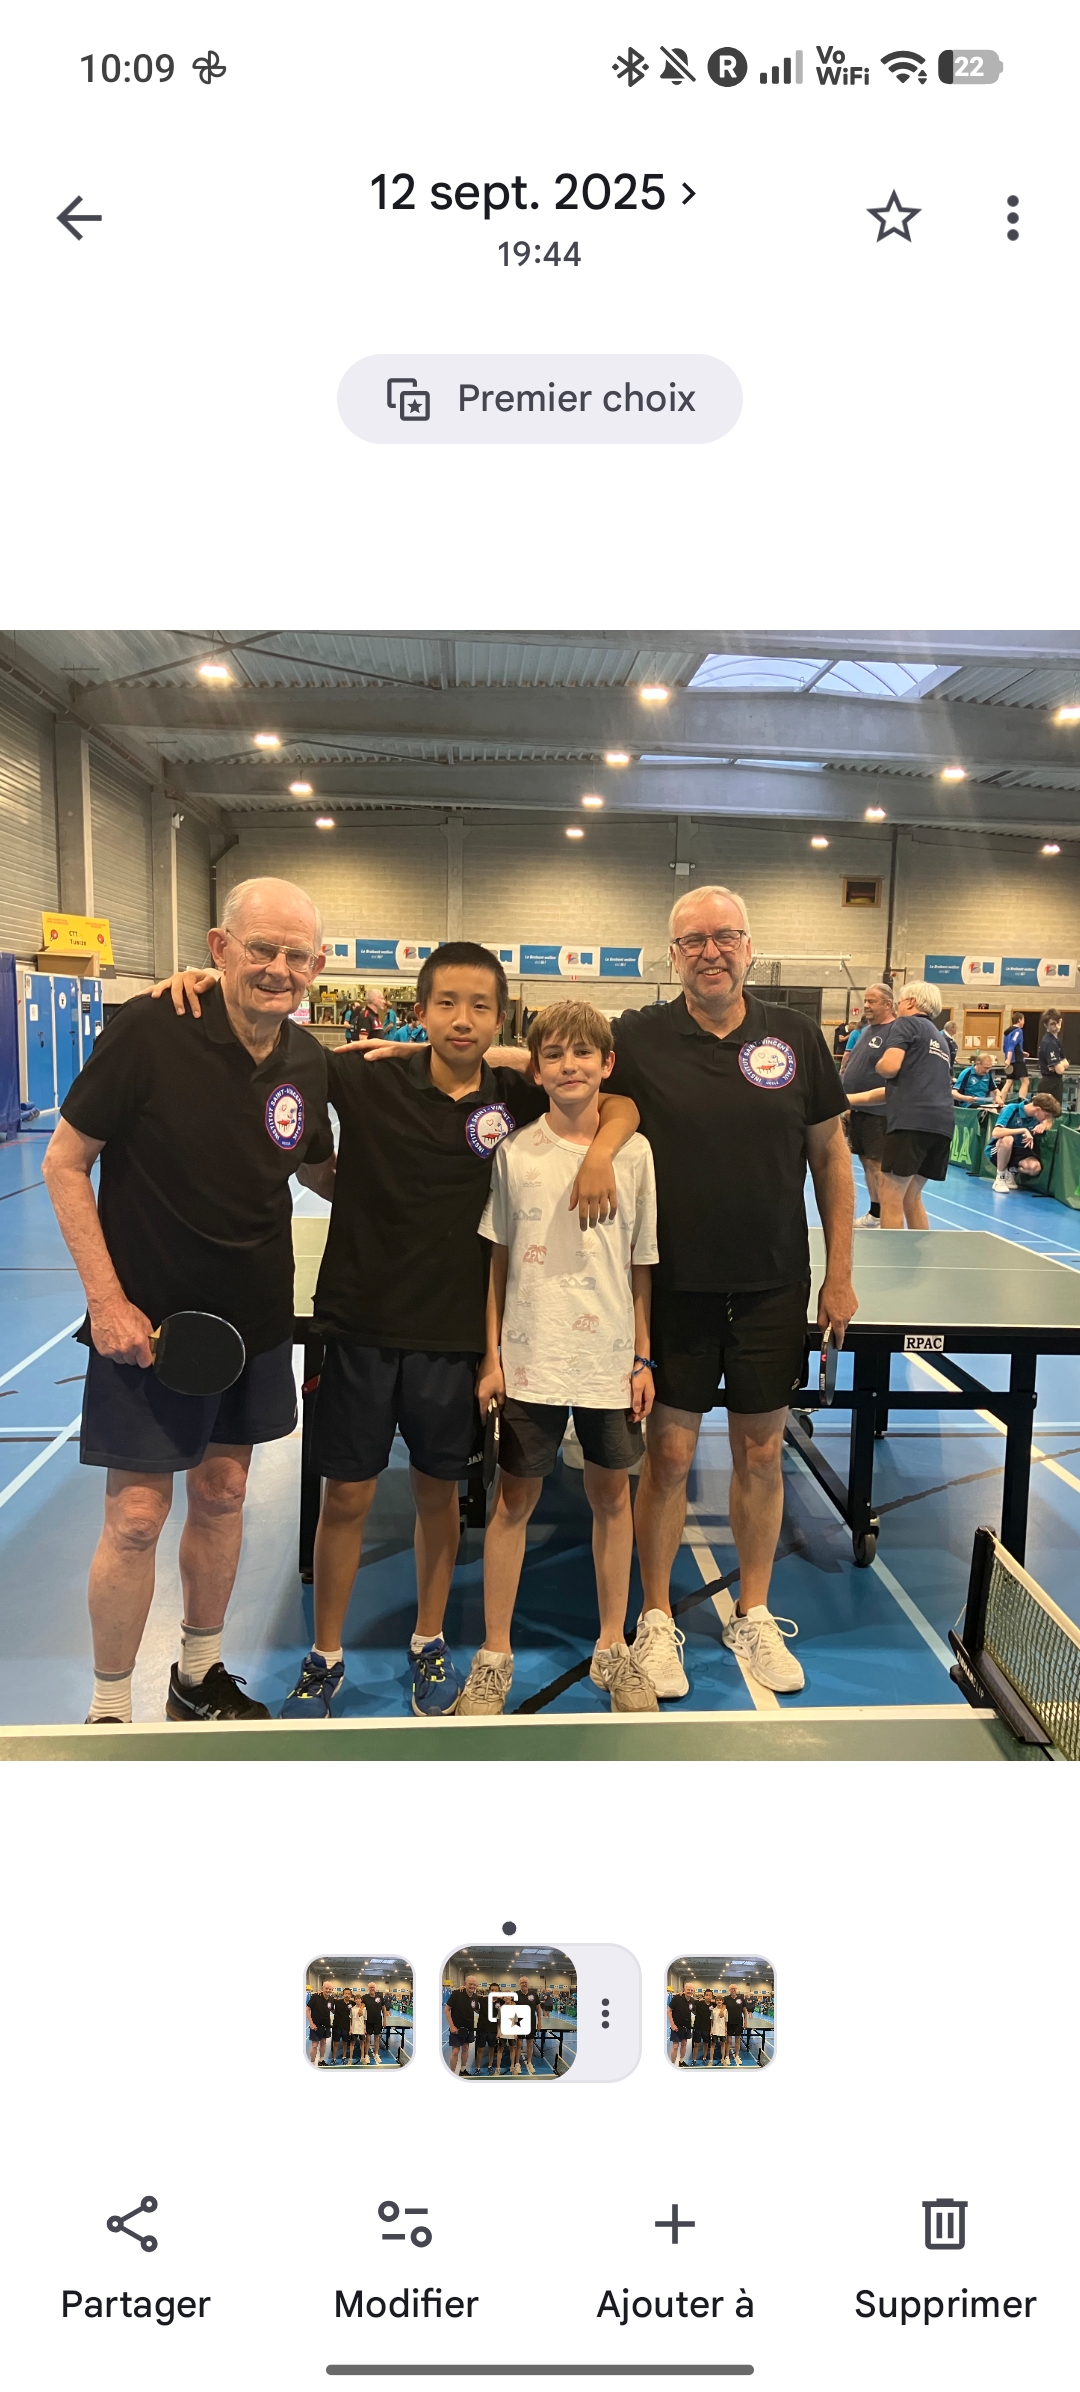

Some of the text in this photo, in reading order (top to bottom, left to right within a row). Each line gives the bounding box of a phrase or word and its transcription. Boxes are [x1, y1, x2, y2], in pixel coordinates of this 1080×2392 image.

[80, 53, 175, 83] 10:09
[815, 45, 846, 65] Vo
[954, 56, 985, 77] 22
[815, 66, 870, 86] WiFi
[371, 172, 666, 221] 12 sept. 2025
[498, 240, 582, 267] 19:44
[459, 381, 696, 412] Premier choix
[742, 1057, 762, 1083] INSTITUT
[268, 1106, 280, 1141] INSTITUT
[469, 1123, 485, 1154] INSTITUT
[906, 1337, 942, 1350] RPAC
[62, 2288, 211, 2327] Partager
[335, 2287, 479, 2318] Modifier
[596, 2287, 754, 2326] Ajouter à
[855, 2287, 1037, 2326] Supprimer
